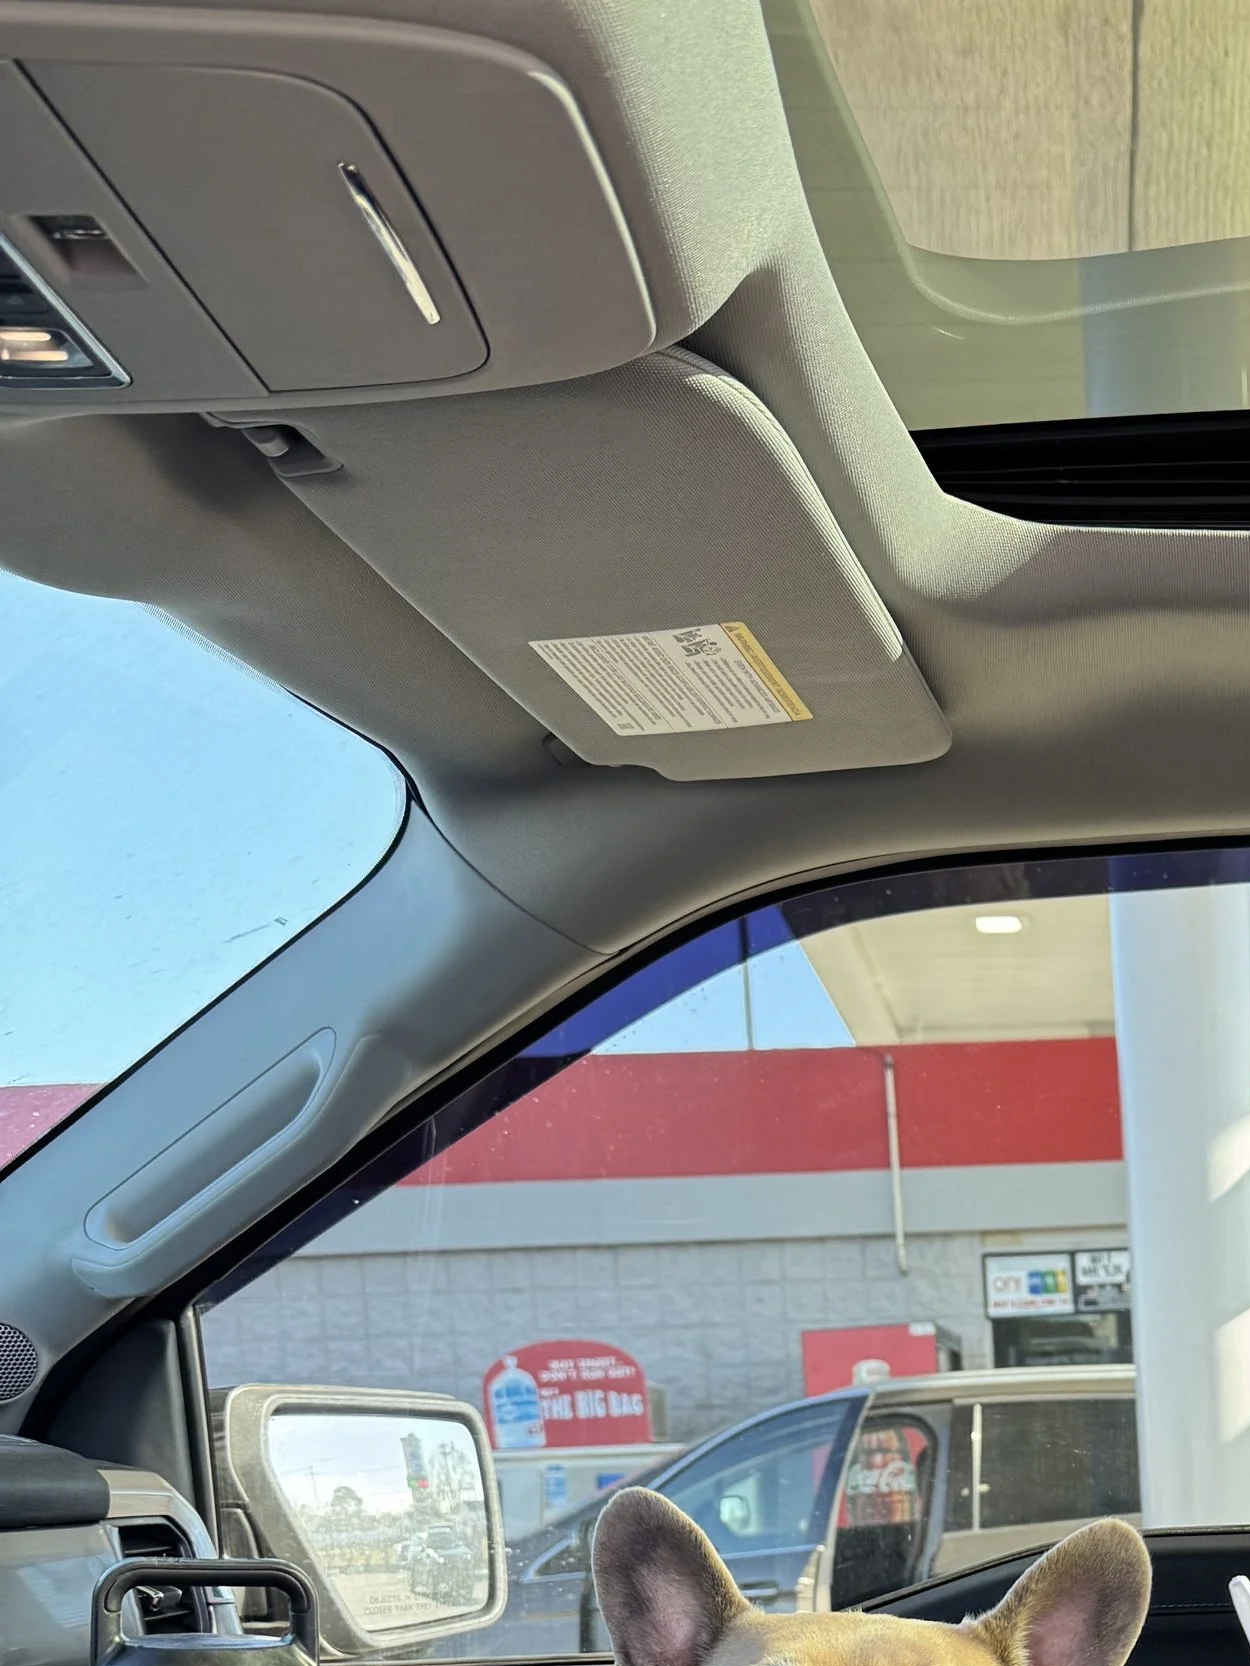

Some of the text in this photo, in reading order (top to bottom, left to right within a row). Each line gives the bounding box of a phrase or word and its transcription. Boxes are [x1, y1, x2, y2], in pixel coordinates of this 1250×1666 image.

[541, 1394, 573, 1420] THE
[574, 1389, 606, 1418] BIG
[607, 1389, 644, 1417] BAG
